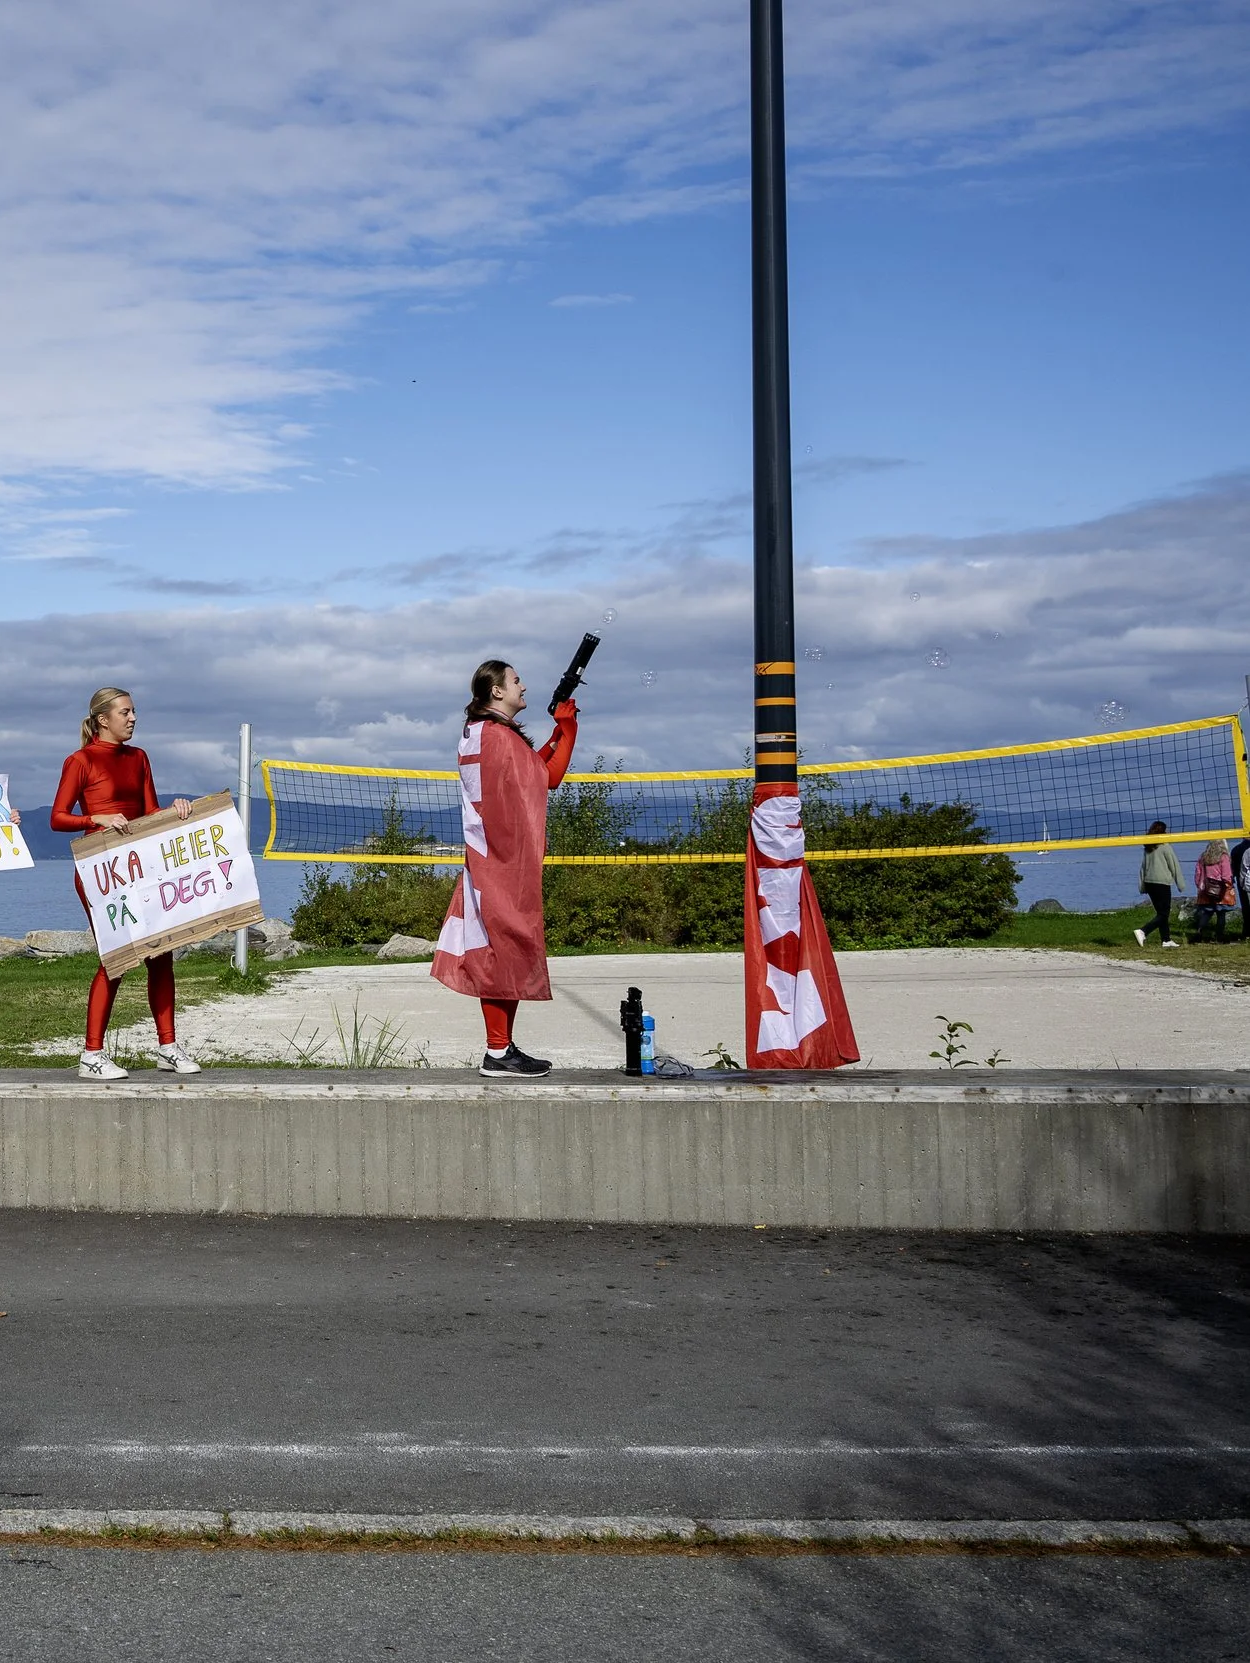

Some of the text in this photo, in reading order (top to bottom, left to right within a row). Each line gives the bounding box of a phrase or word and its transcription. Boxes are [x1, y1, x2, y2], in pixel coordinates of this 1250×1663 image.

[93, 824, 230, 896] UKA HEIER
[105, 894, 138, 932] PÅ
[158, 859, 233, 912] DEG!
